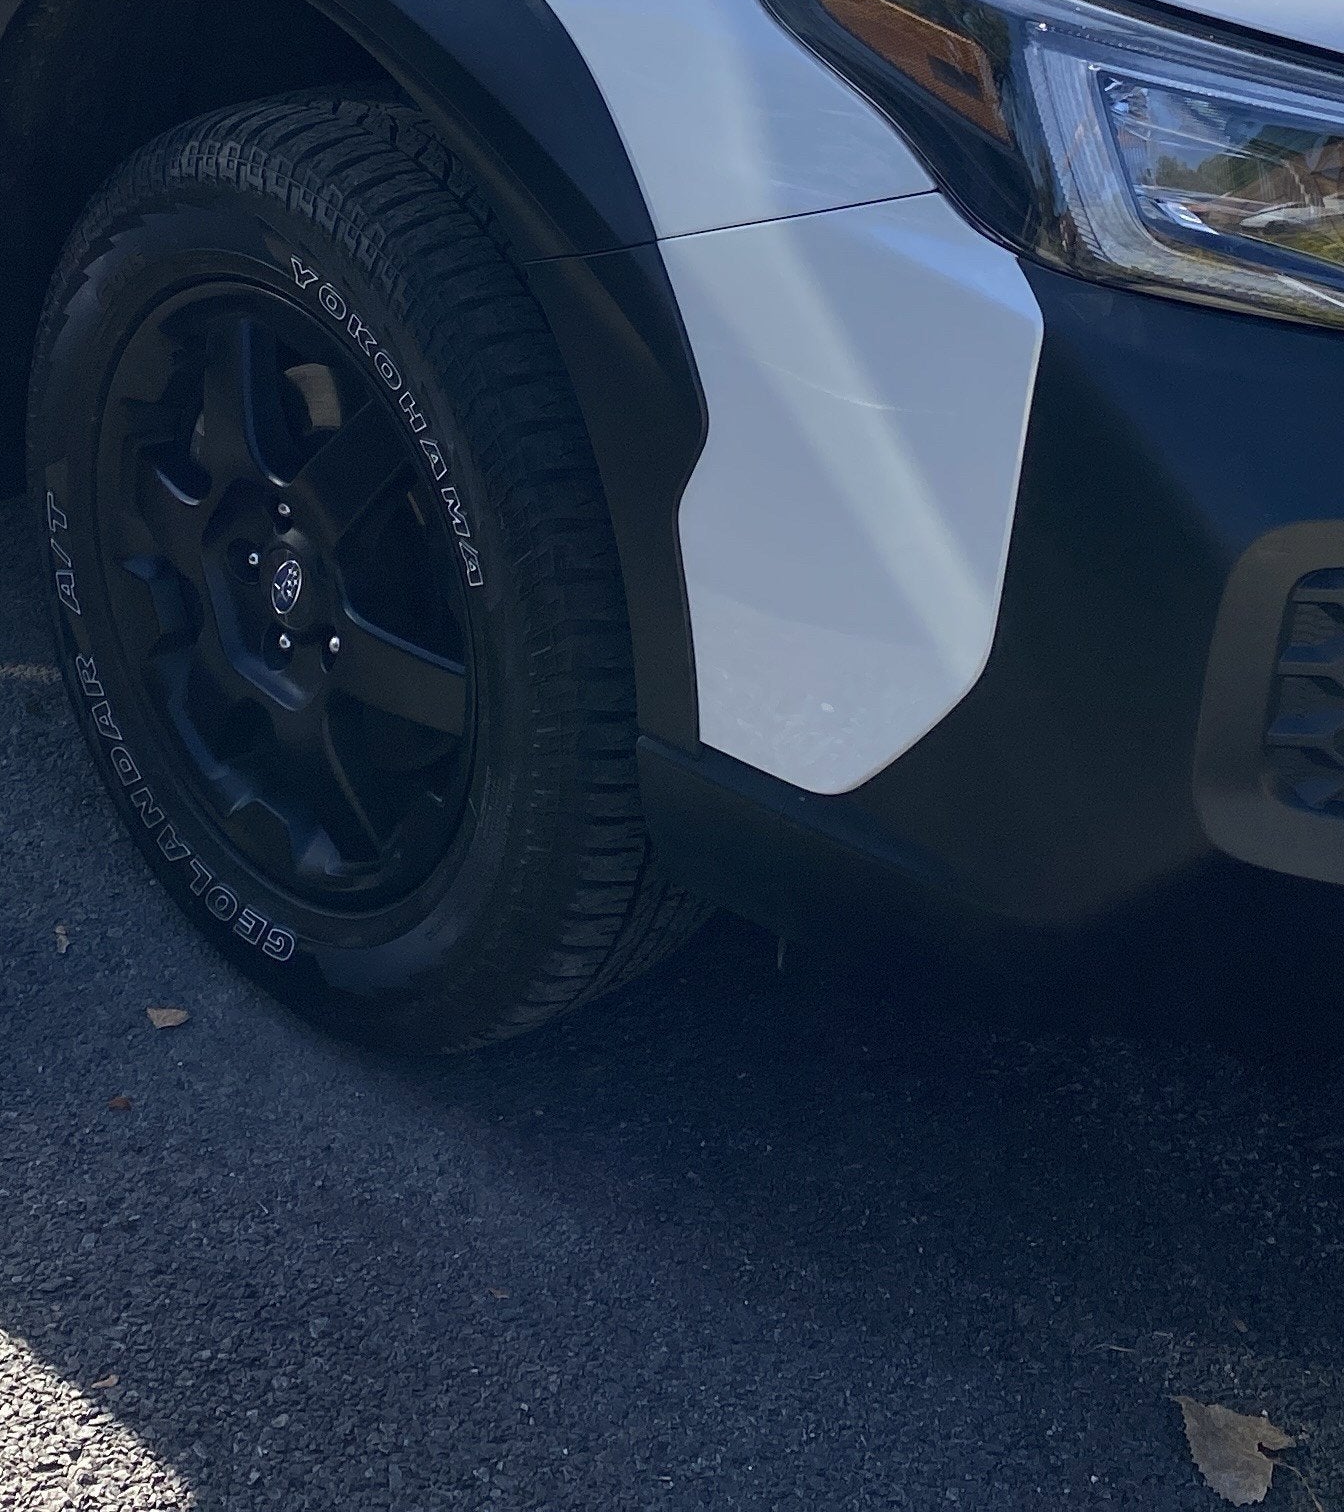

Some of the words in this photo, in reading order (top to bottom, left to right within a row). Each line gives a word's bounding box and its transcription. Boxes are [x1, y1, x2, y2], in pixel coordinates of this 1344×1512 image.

[46, 490, 82, 615] A/T
[290, 253, 484, 587] YOKOHAMA
[75, 655, 297, 962] GEOLANDAR
